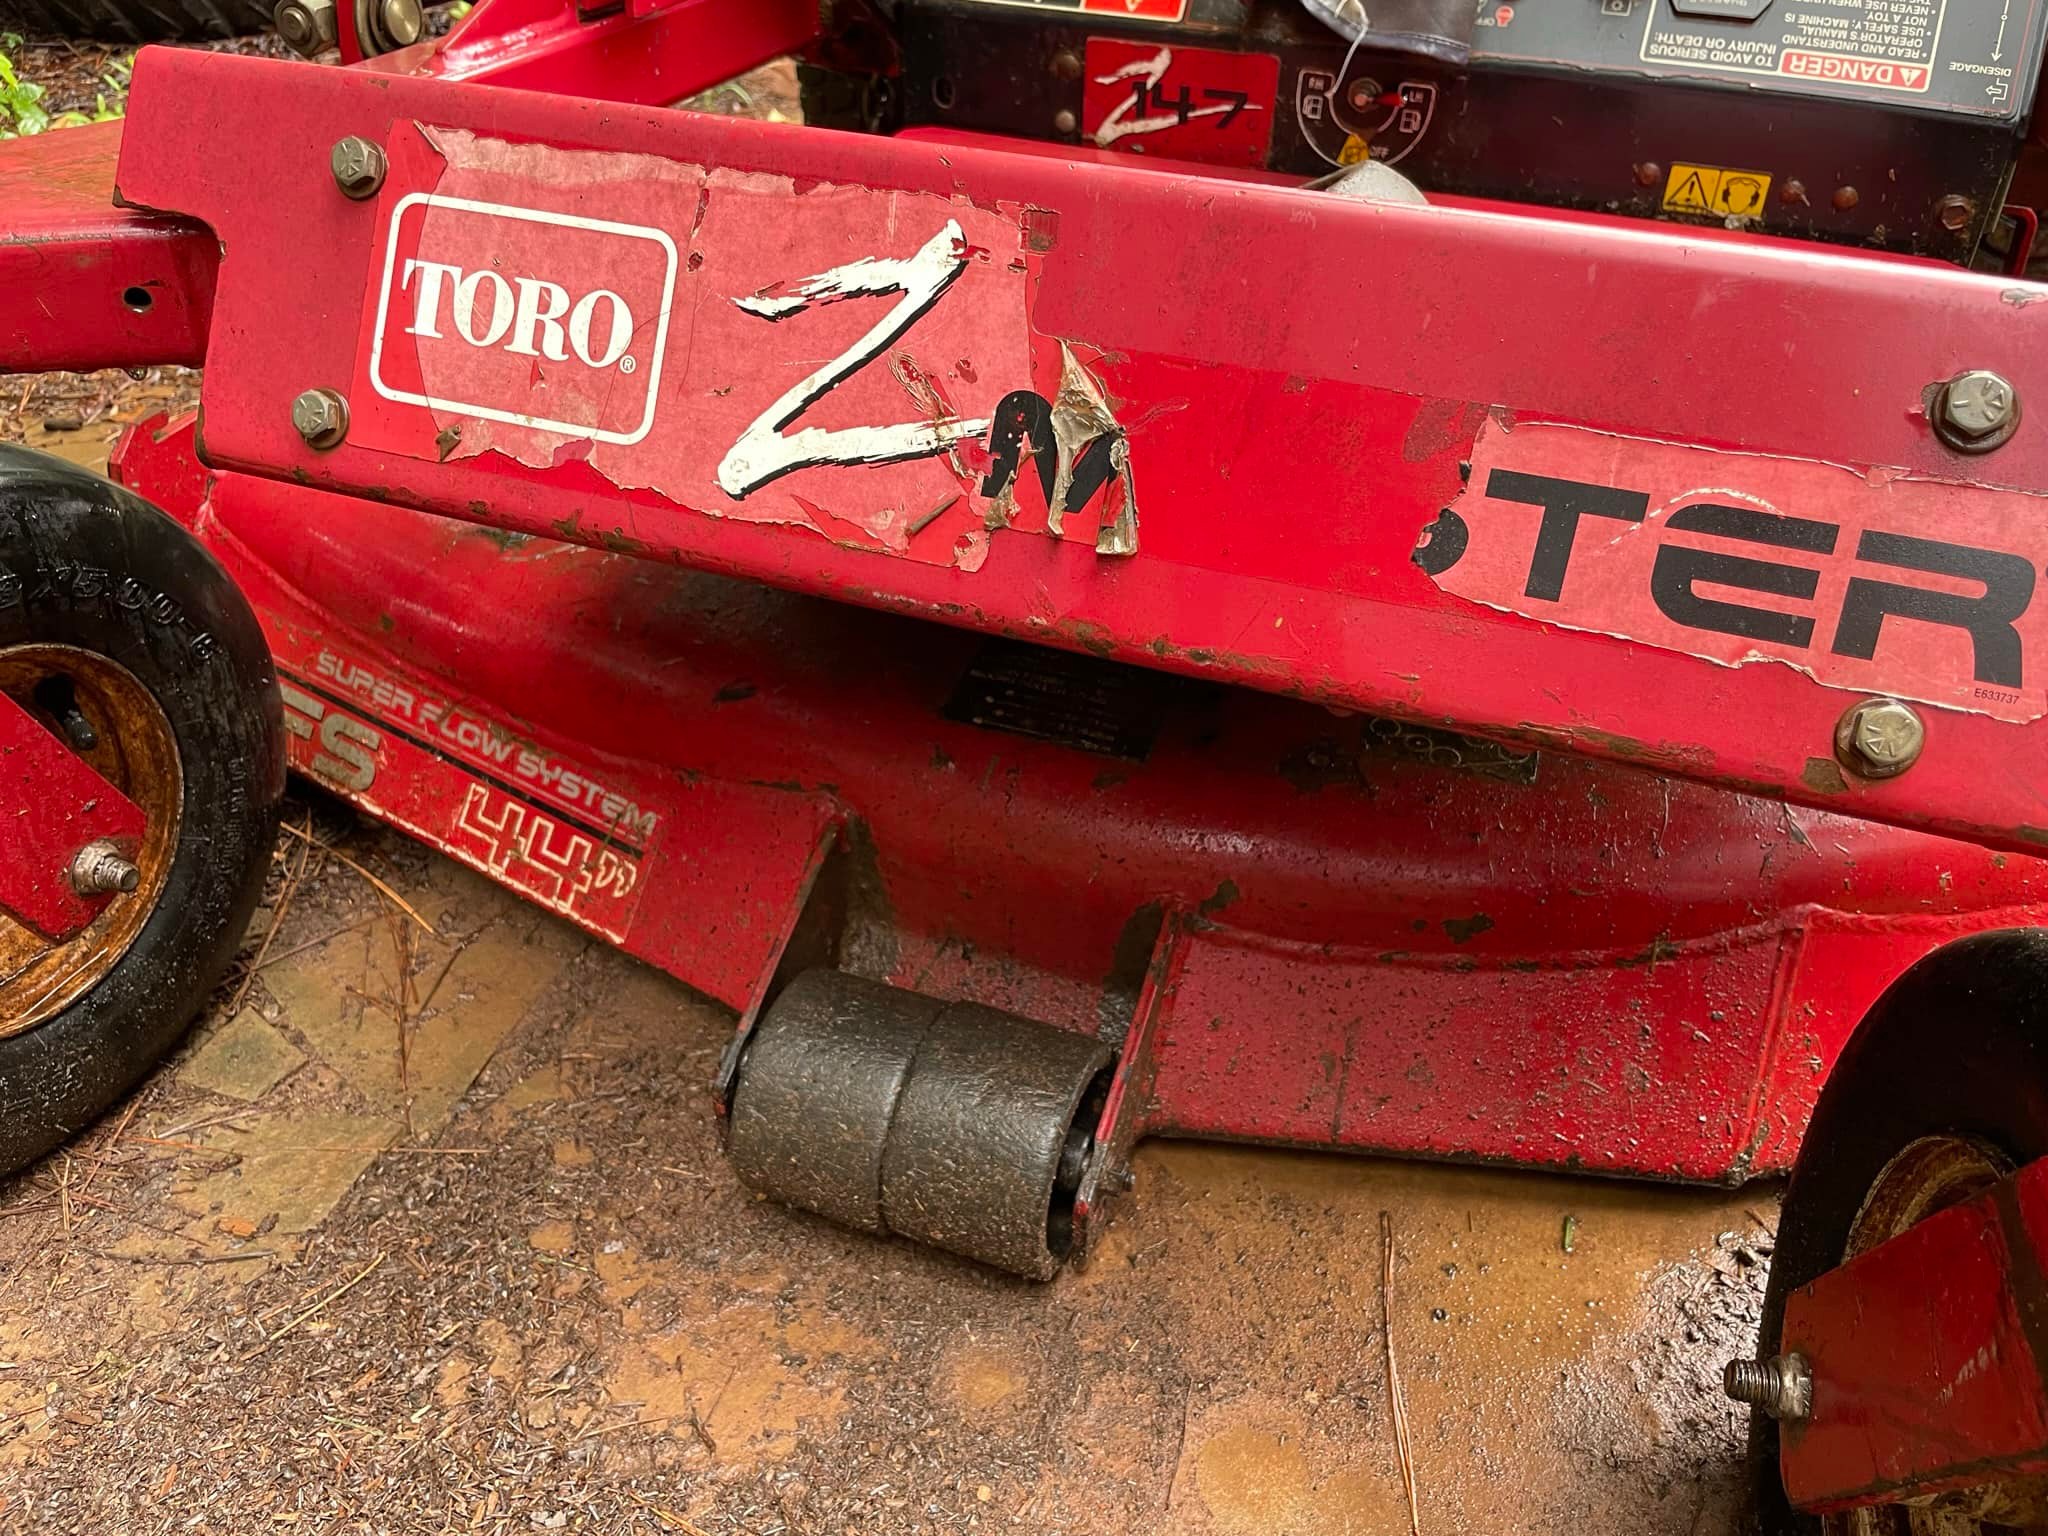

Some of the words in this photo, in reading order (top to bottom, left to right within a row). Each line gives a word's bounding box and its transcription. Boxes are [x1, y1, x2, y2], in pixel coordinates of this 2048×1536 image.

[1865, 1, 1888, 12] USE
[1890, 3, 1929, 16] NEVER
[1785, 12, 1796, 23] IS
[1798, 14, 1848, 28] MACHINE
[1865, 11, 1890, 22] TOY.
[1893, 14, 1901, 23] A
[1903, 15, 1927, 27] NOT
[1797, 25, 1848, 39] MANUAL.
[1852, 20, 1898, 34] SAFELY;
[1901, 26, 1924, 37] USE
[1706, 37, 1726, 49] OR
[1782, 34, 1859, 51] UNDERSTAND
[1850, 31, 1923, 48] OPERATOR'S
[1650, 43, 1707, 60] SERIOUS
[1728, 39, 1777, 55] INJURY
[1861, 43, 1886, 55] AND
[1888, 46, 1920, 59] READ
[1711, 49, 1750, 64] AVOID
[1755, 54, 1774, 67] TO
[1789, 55, 1894, 83] DANGER
[1949, 61, 2012, 77] DISENGAGE
[1133, 81, 1248, 129] 147
[714, 217, 989, 500] Z
[1974, 687, 2020, 705] E633737
[316, 651, 416, 716] SUPER
[418, 701, 513, 763] FLOW
[515, 752, 661, 836] SYSTEM
